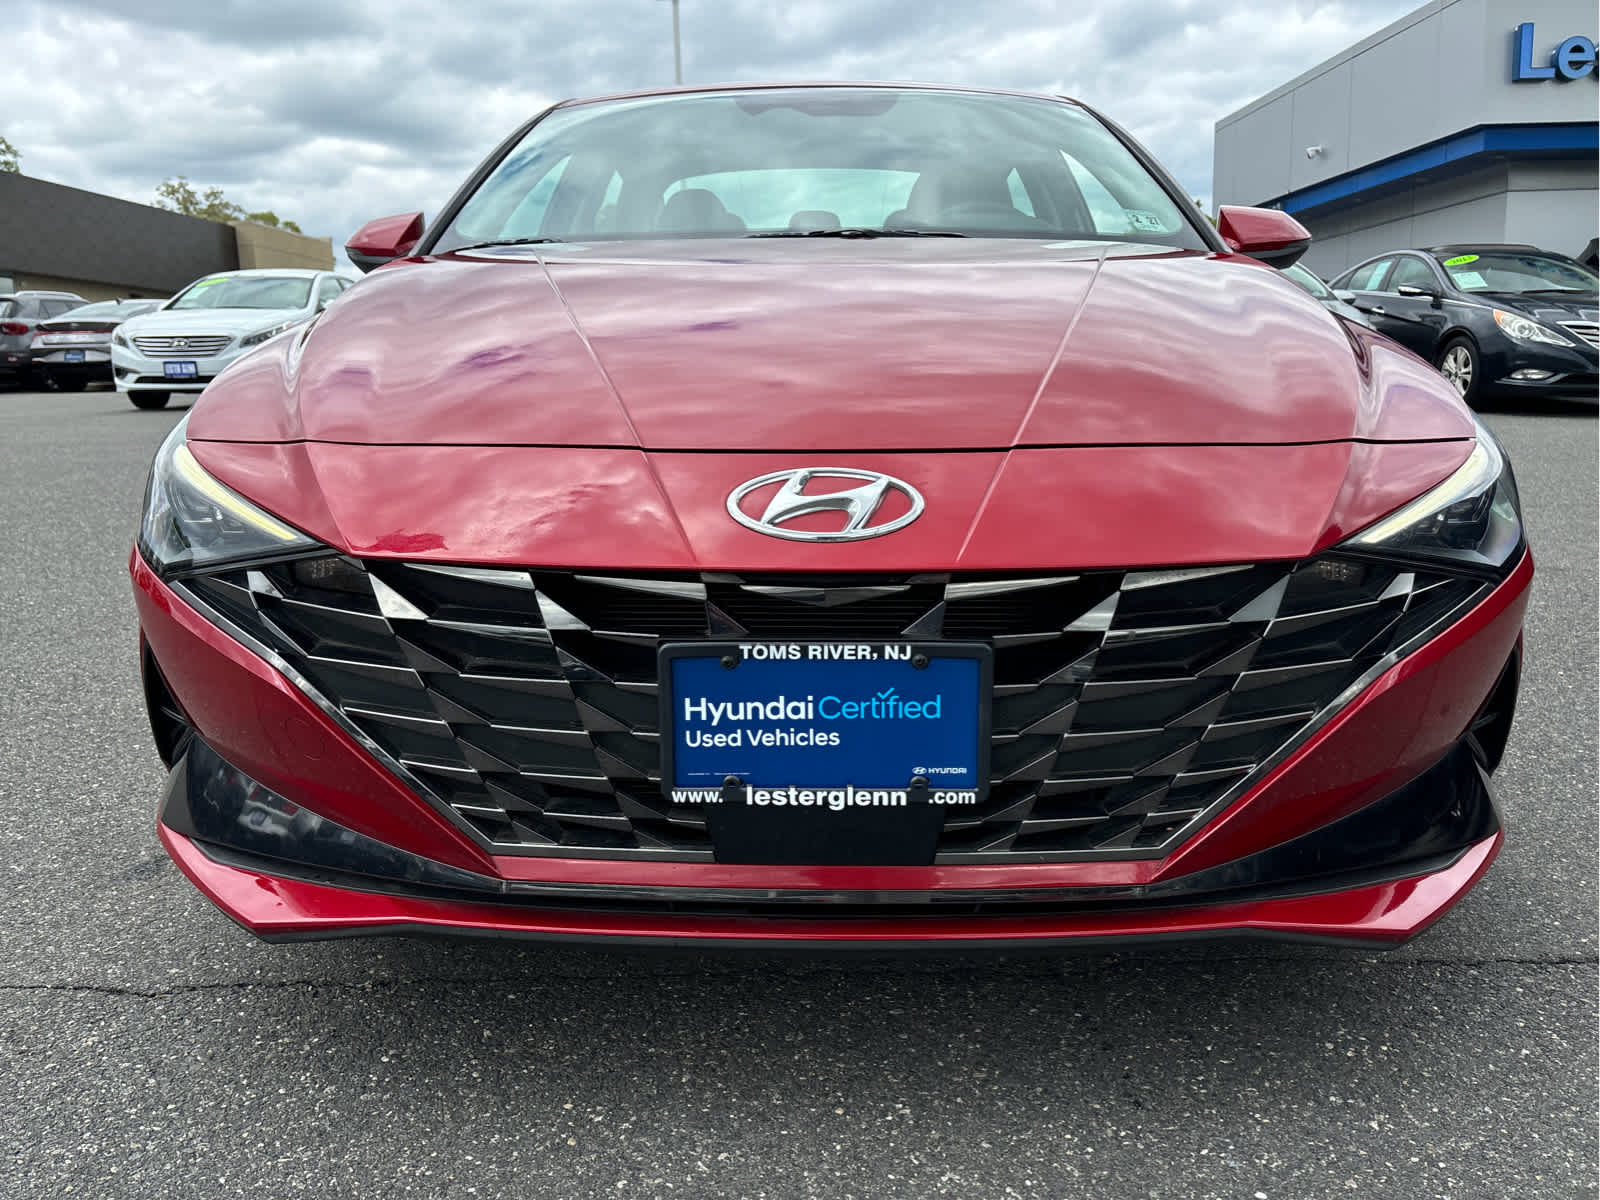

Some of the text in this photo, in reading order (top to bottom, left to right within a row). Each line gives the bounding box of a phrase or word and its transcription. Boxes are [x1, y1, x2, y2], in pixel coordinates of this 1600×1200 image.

[1512, 22, 1599, 81] Le
[739, 645, 911, 661] TOMS RIVER, NJ
[684, 687, 942, 726] Hyundai Certified
[685, 728, 841, 748] Used Vehicles
[671, 785, 976, 811] www. lesterglenn .com
